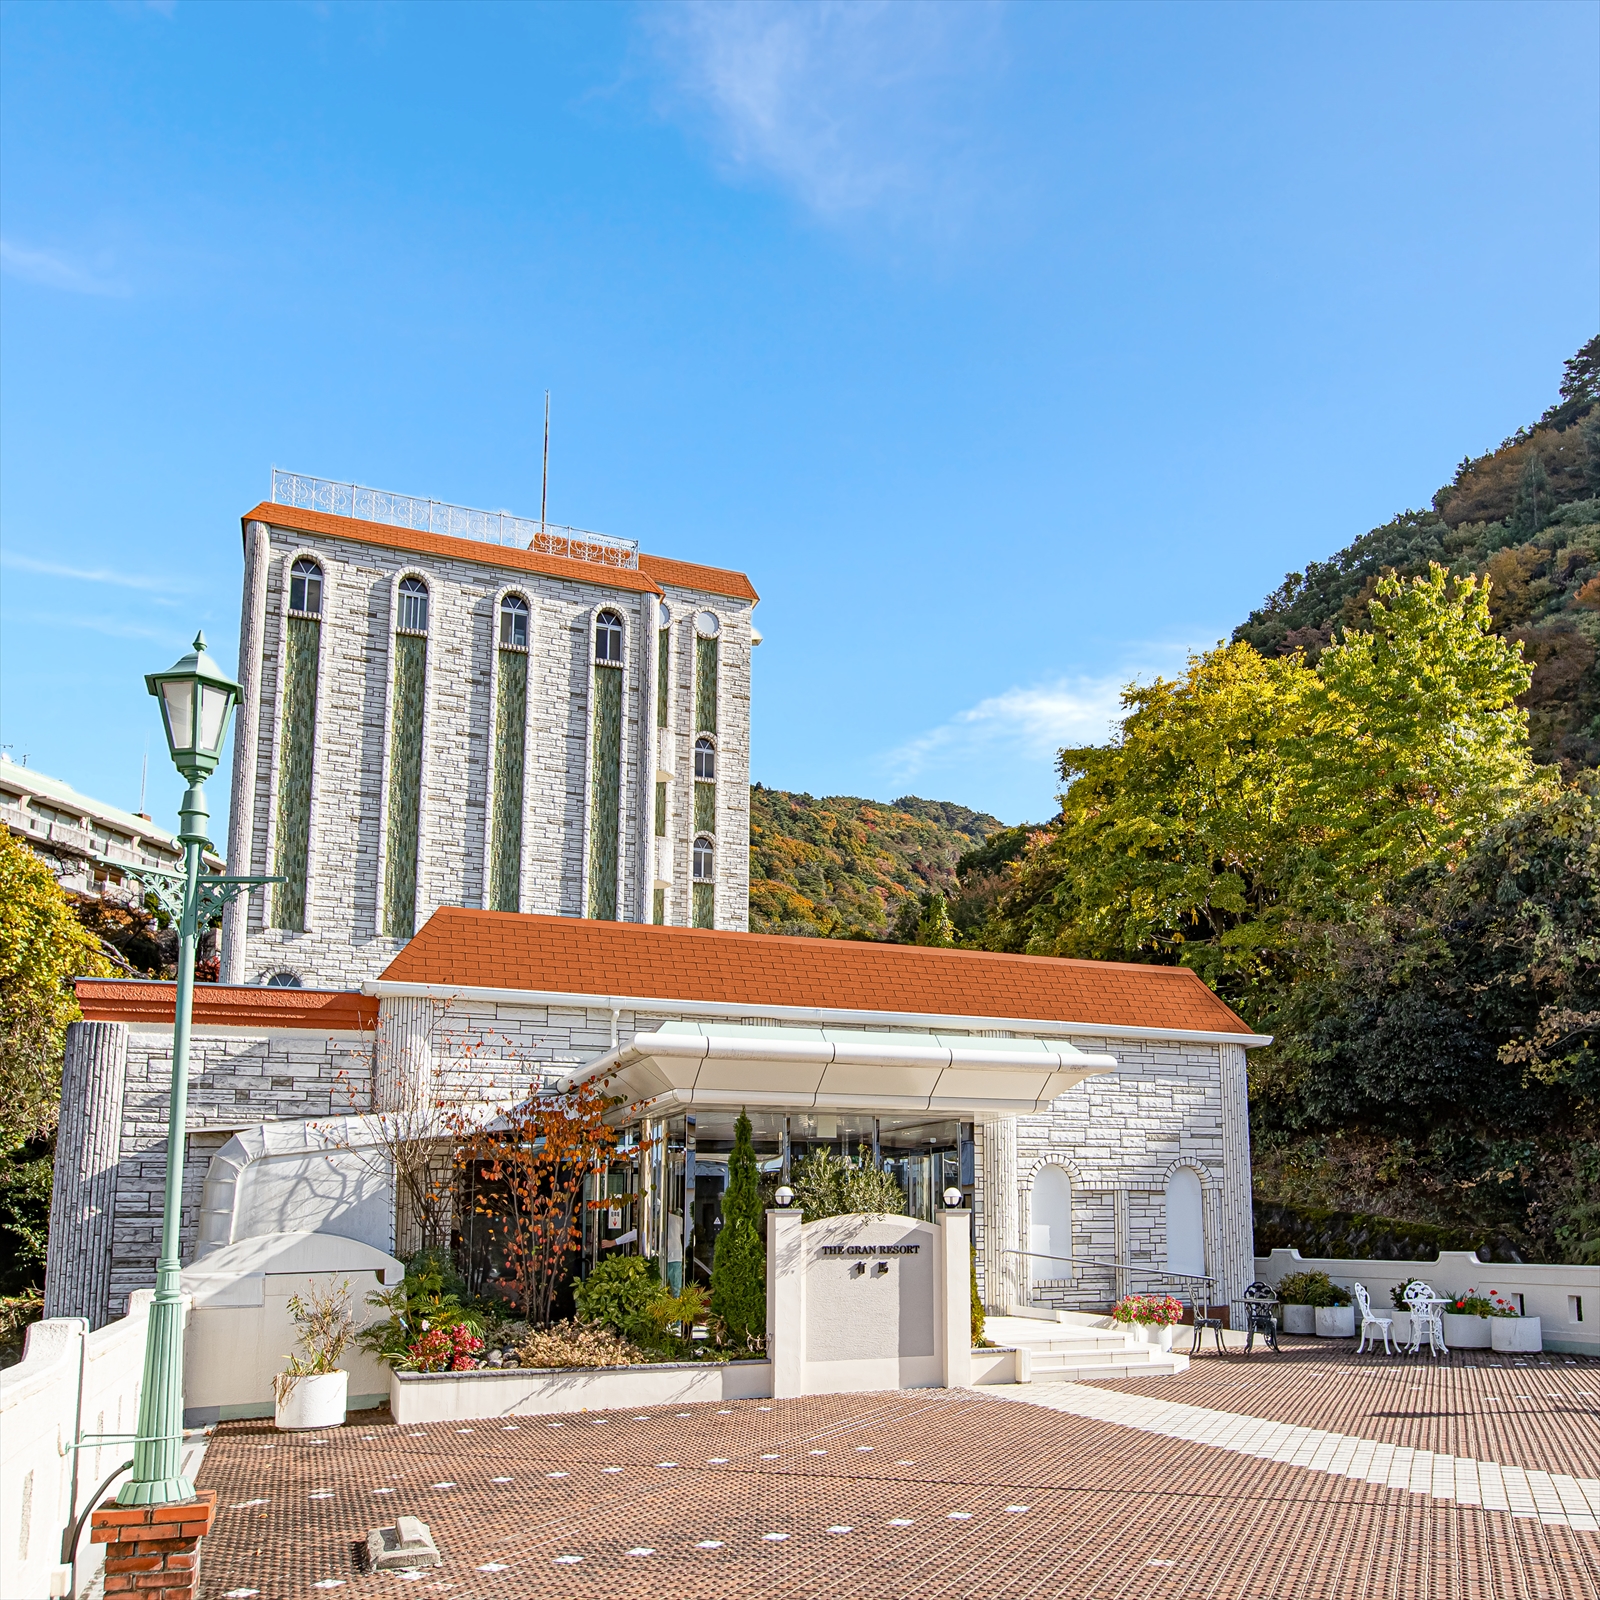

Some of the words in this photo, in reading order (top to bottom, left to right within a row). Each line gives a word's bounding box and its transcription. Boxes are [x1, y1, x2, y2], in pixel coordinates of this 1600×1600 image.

[822, 1245, 845, 1255] THE
[846, 1245, 876, 1255] GRAN
[879, 1244, 920, 1255] RESORT
